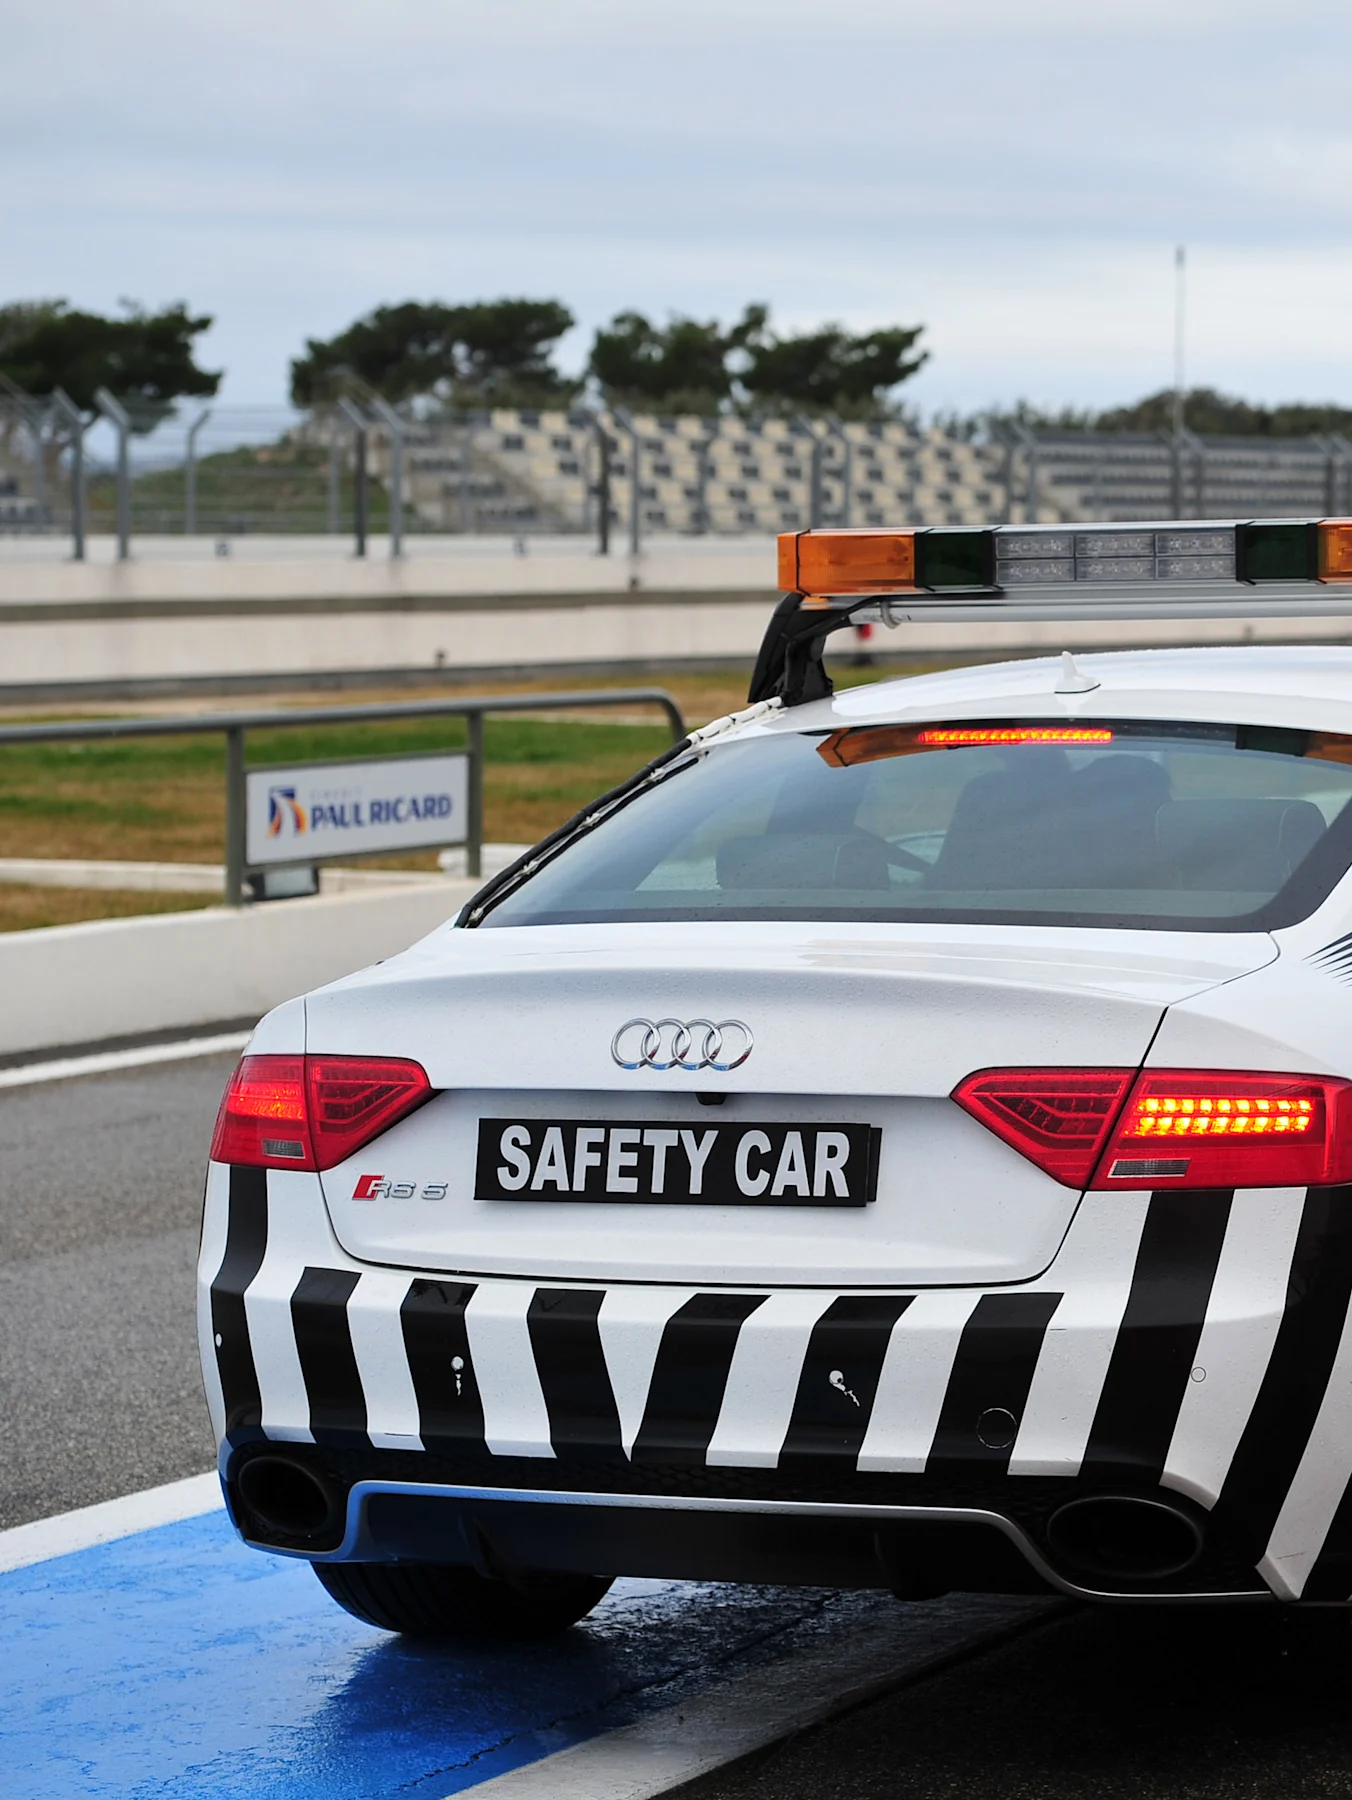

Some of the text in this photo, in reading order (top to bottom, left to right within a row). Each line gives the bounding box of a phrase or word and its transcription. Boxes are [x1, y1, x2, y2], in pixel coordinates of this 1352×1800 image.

[311, 801, 364, 831] PAUL
[369, 792, 453, 826] RICARD
[497, 1125, 851, 1198] SAFETY CAR
[353, 1175, 449, 1201] RS 5
